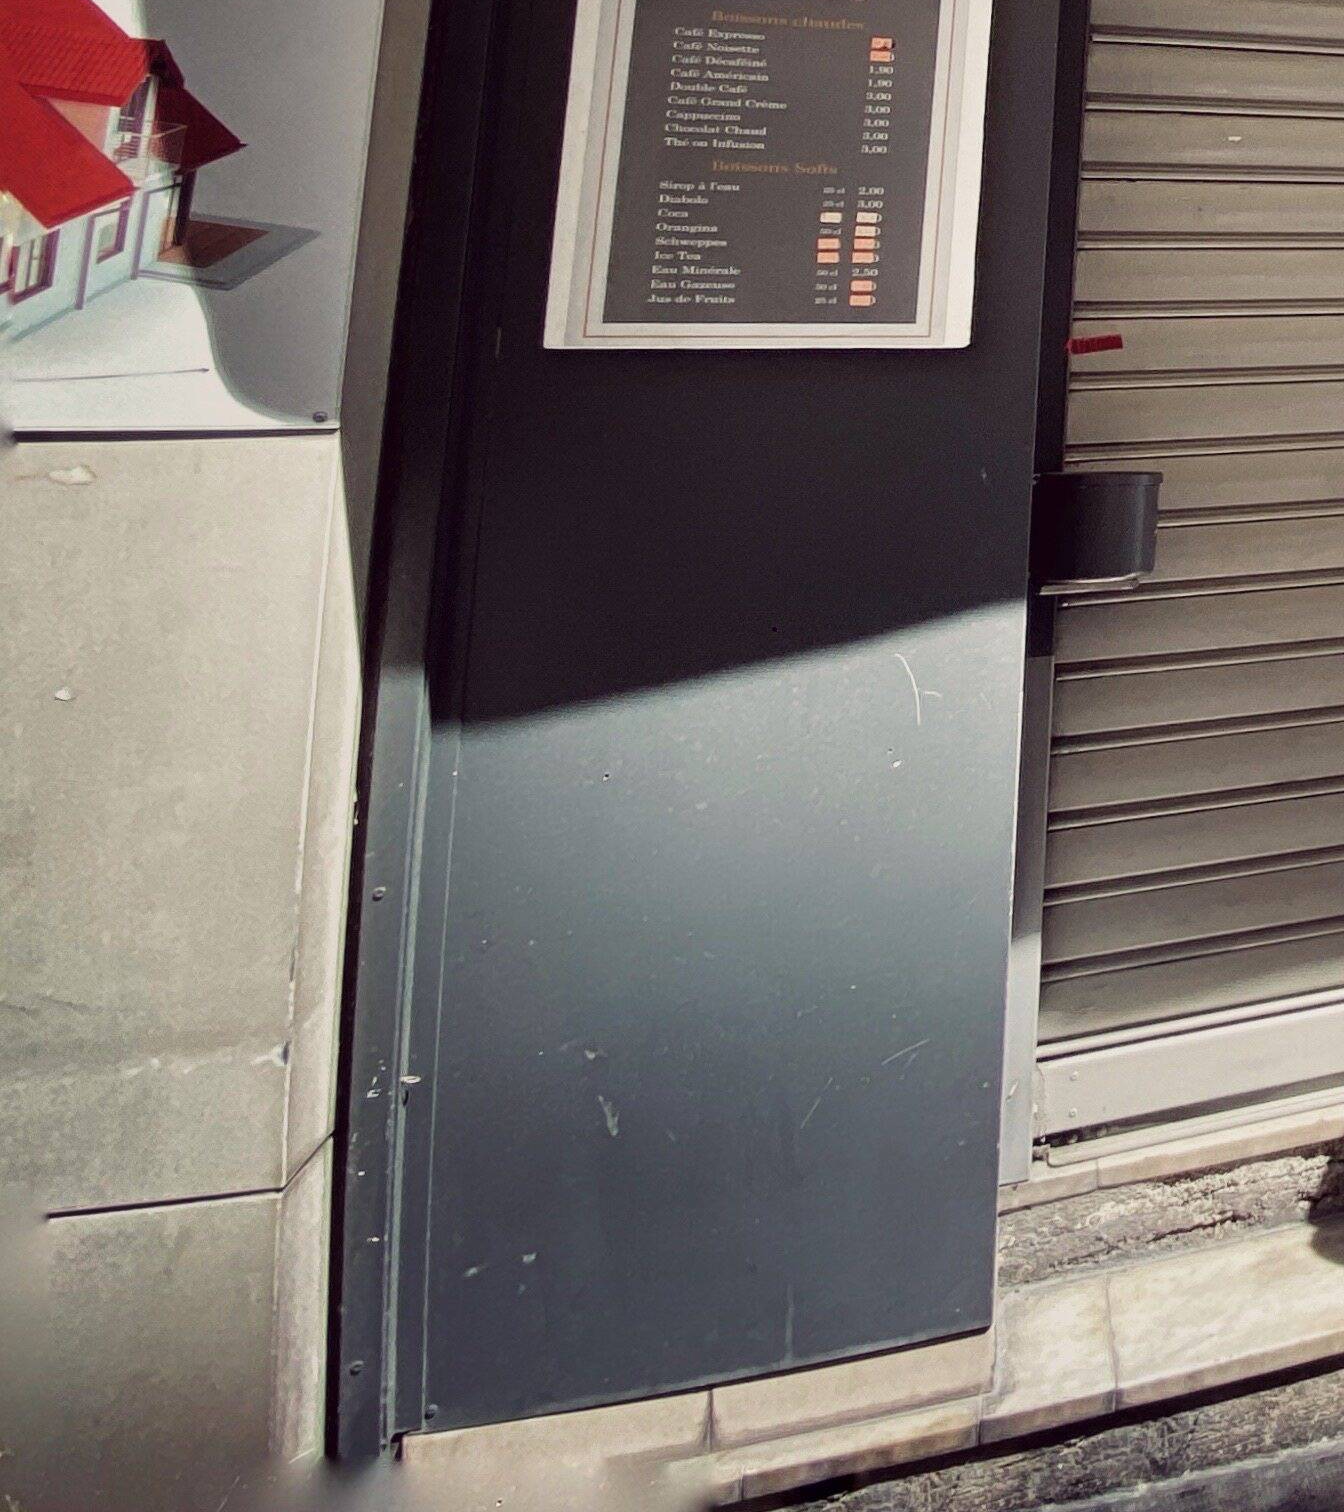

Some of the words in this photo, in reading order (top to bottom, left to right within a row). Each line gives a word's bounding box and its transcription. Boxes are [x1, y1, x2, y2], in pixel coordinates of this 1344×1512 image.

[674, 27, 704, 37] Café
[673, 40, 702, 50] Café
[707, 42, 759, 54] Noisette
[671, 54, 700, 64] Café
[670, 68, 700, 78] Café
[670, 81, 715, 92] Double
[719, 83, 748, 94] Café
[667, 95, 697, 106] Café
[701, 96, 741, 108] Grand
[666, 109, 740, 122] Cappuccino
[665, 123, 720, 134] Chocolat
[725, 124, 767, 136] Chaud
[664, 137, 689, 147] Thé
[712, 138, 765, 150] Infusion
[658, 194, 709, 205] Diabolo
[657, 208, 689, 218] Coca
[655, 222, 718, 234] Orangina
[655, 237, 727, 248] Schweppes
[651, 265, 678, 275] Eau
[683, 265, 741, 276] Minérale
[650, 279, 676, 289] Eau
[680, 279, 736, 290] Gazeuse
[647, 294, 672, 304] Jus
[695, 294, 735, 305] Fruits
